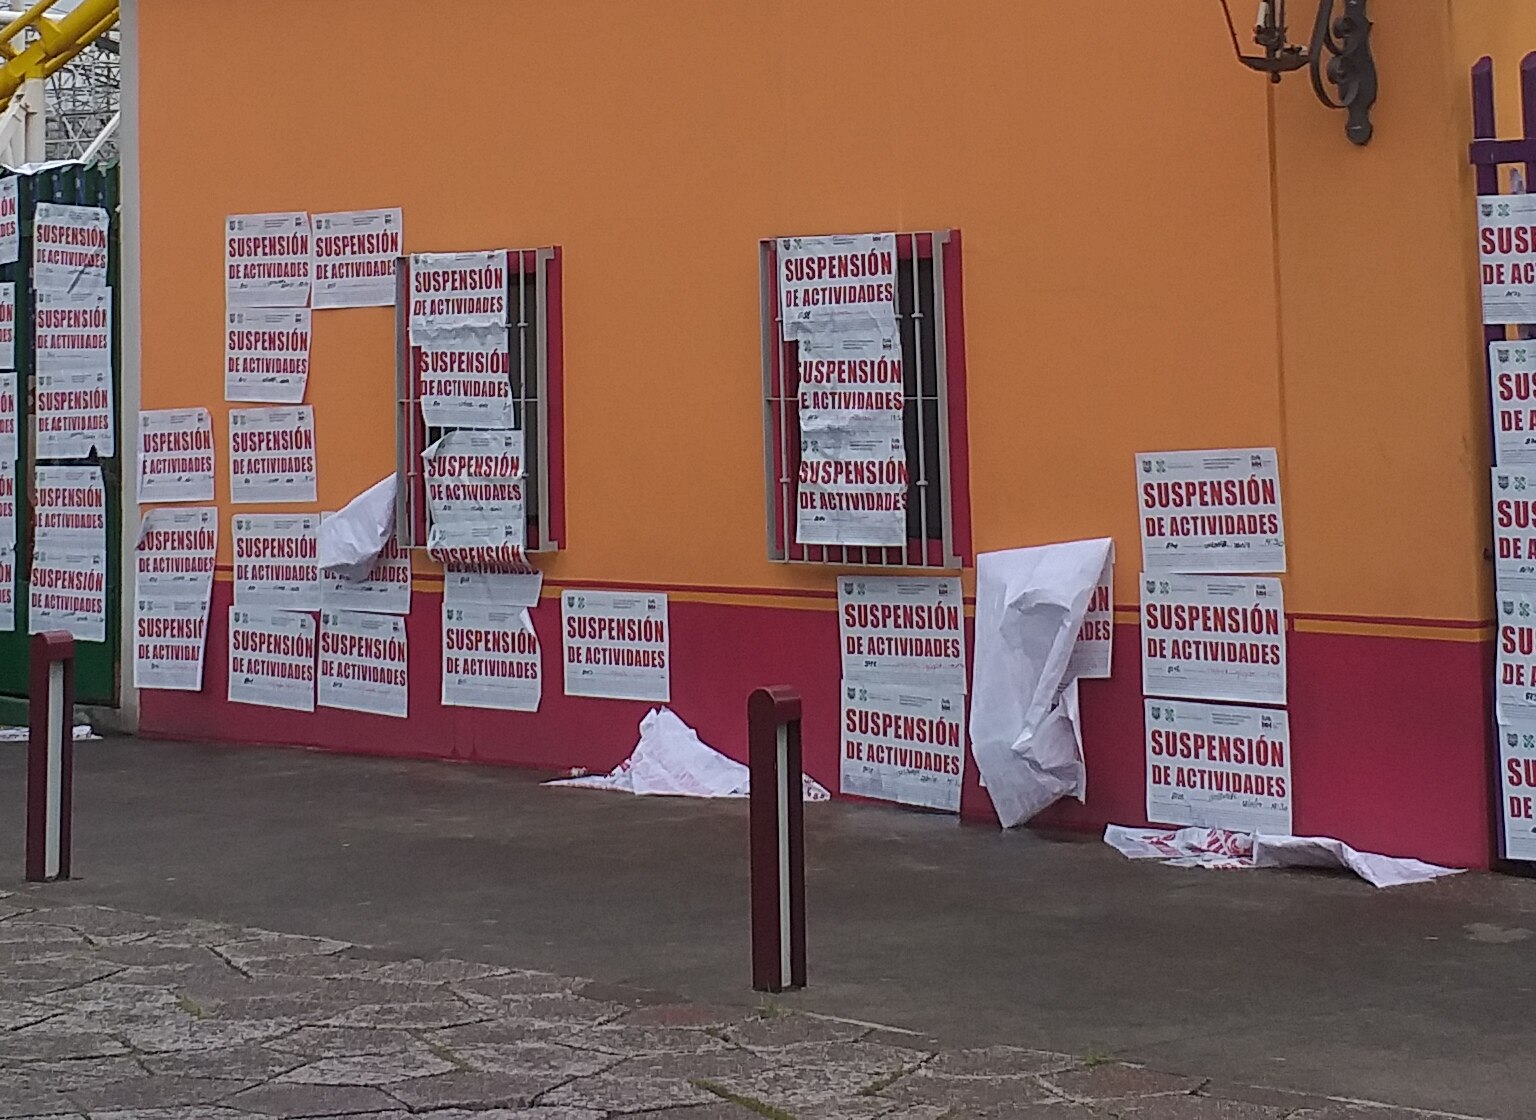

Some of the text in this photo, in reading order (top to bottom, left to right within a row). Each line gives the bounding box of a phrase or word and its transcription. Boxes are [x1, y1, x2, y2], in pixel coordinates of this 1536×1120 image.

[230, 231, 308, 257] SUSPENSIÓN
[230, 263, 308, 279] DE ACTIVIDADES
[416, 264, 502, 292] SUSPENSIÓN
[786, 252, 892, 280] SUSPENSIÓN
[1483, 264, 1505, 285] DE
[414, 297, 501, 315] DE ACTIVIDADES
[786, 285, 892, 306] DE ACTIVIDADES
[229, 327, 308, 351] SUSPENSIÓN
[227, 356, 307, 374] DE ACTIVIDADES
[1501, 411, 1521, 431] DE
[1144, 473, 1275, 508] SUSPENSIÓN
[1146, 514, 1277, 536] DE ACTIVIDADES
[237, 534, 317, 558] SUSPENSIÓN
[237, 565, 316, 580] DE ACTIVIDADES
[845, 602, 958, 629] SUSPENSIÓN
[1147, 604, 1278, 634] SUSPENSIÓN
[446, 626, 536, 654] SUSPENSIÓN
[568, 614, 664, 642] SUSPENSIÓN
[233, 629, 313, 658] SUSPENSIÓN
[847, 636, 959, 657] DE ACTIVIDADES
[1148, 639, 1280, 664] DE ACTIVIDADES
[233, 657, 312, 681] DE ACTIVIDADES
[447, 659, 536, 678] DE ACTIVIDADES
[568, 647, 664, 668] DE ACTIVIDADES
[847, 709, 959, 746] SUSPENSIÓN
[846, 741, 959, 775] DE ACTIVIDADES
[1152, 730, 1284, 767] SUSPENSIÓN
[1153, 765, 1285, 798] DE ACTIVIDADES
[1510, 797, 1530, 818] DE
